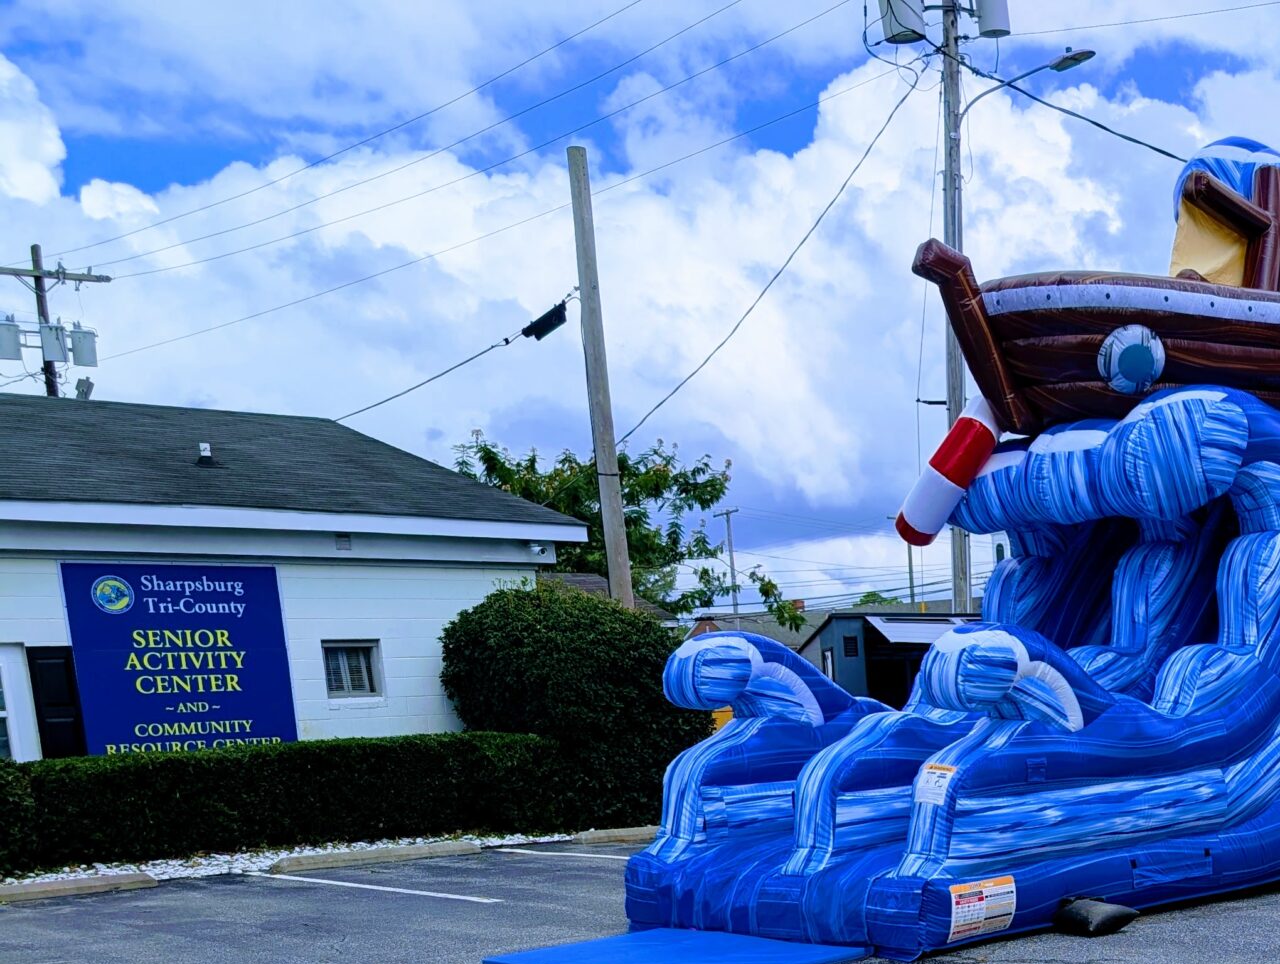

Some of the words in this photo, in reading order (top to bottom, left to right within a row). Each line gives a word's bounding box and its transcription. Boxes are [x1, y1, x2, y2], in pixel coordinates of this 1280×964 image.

[141, 574, 245, 596] Sharpsburg
[143, 598, 246, 618] Tri-County
[132, 629, 233, 649] SENIOR
[124, 651, 247, 671] ACTIVITY
[135, 674, 242, 694] CENTER
[134, 720, 253, 738] COMMUNITY
